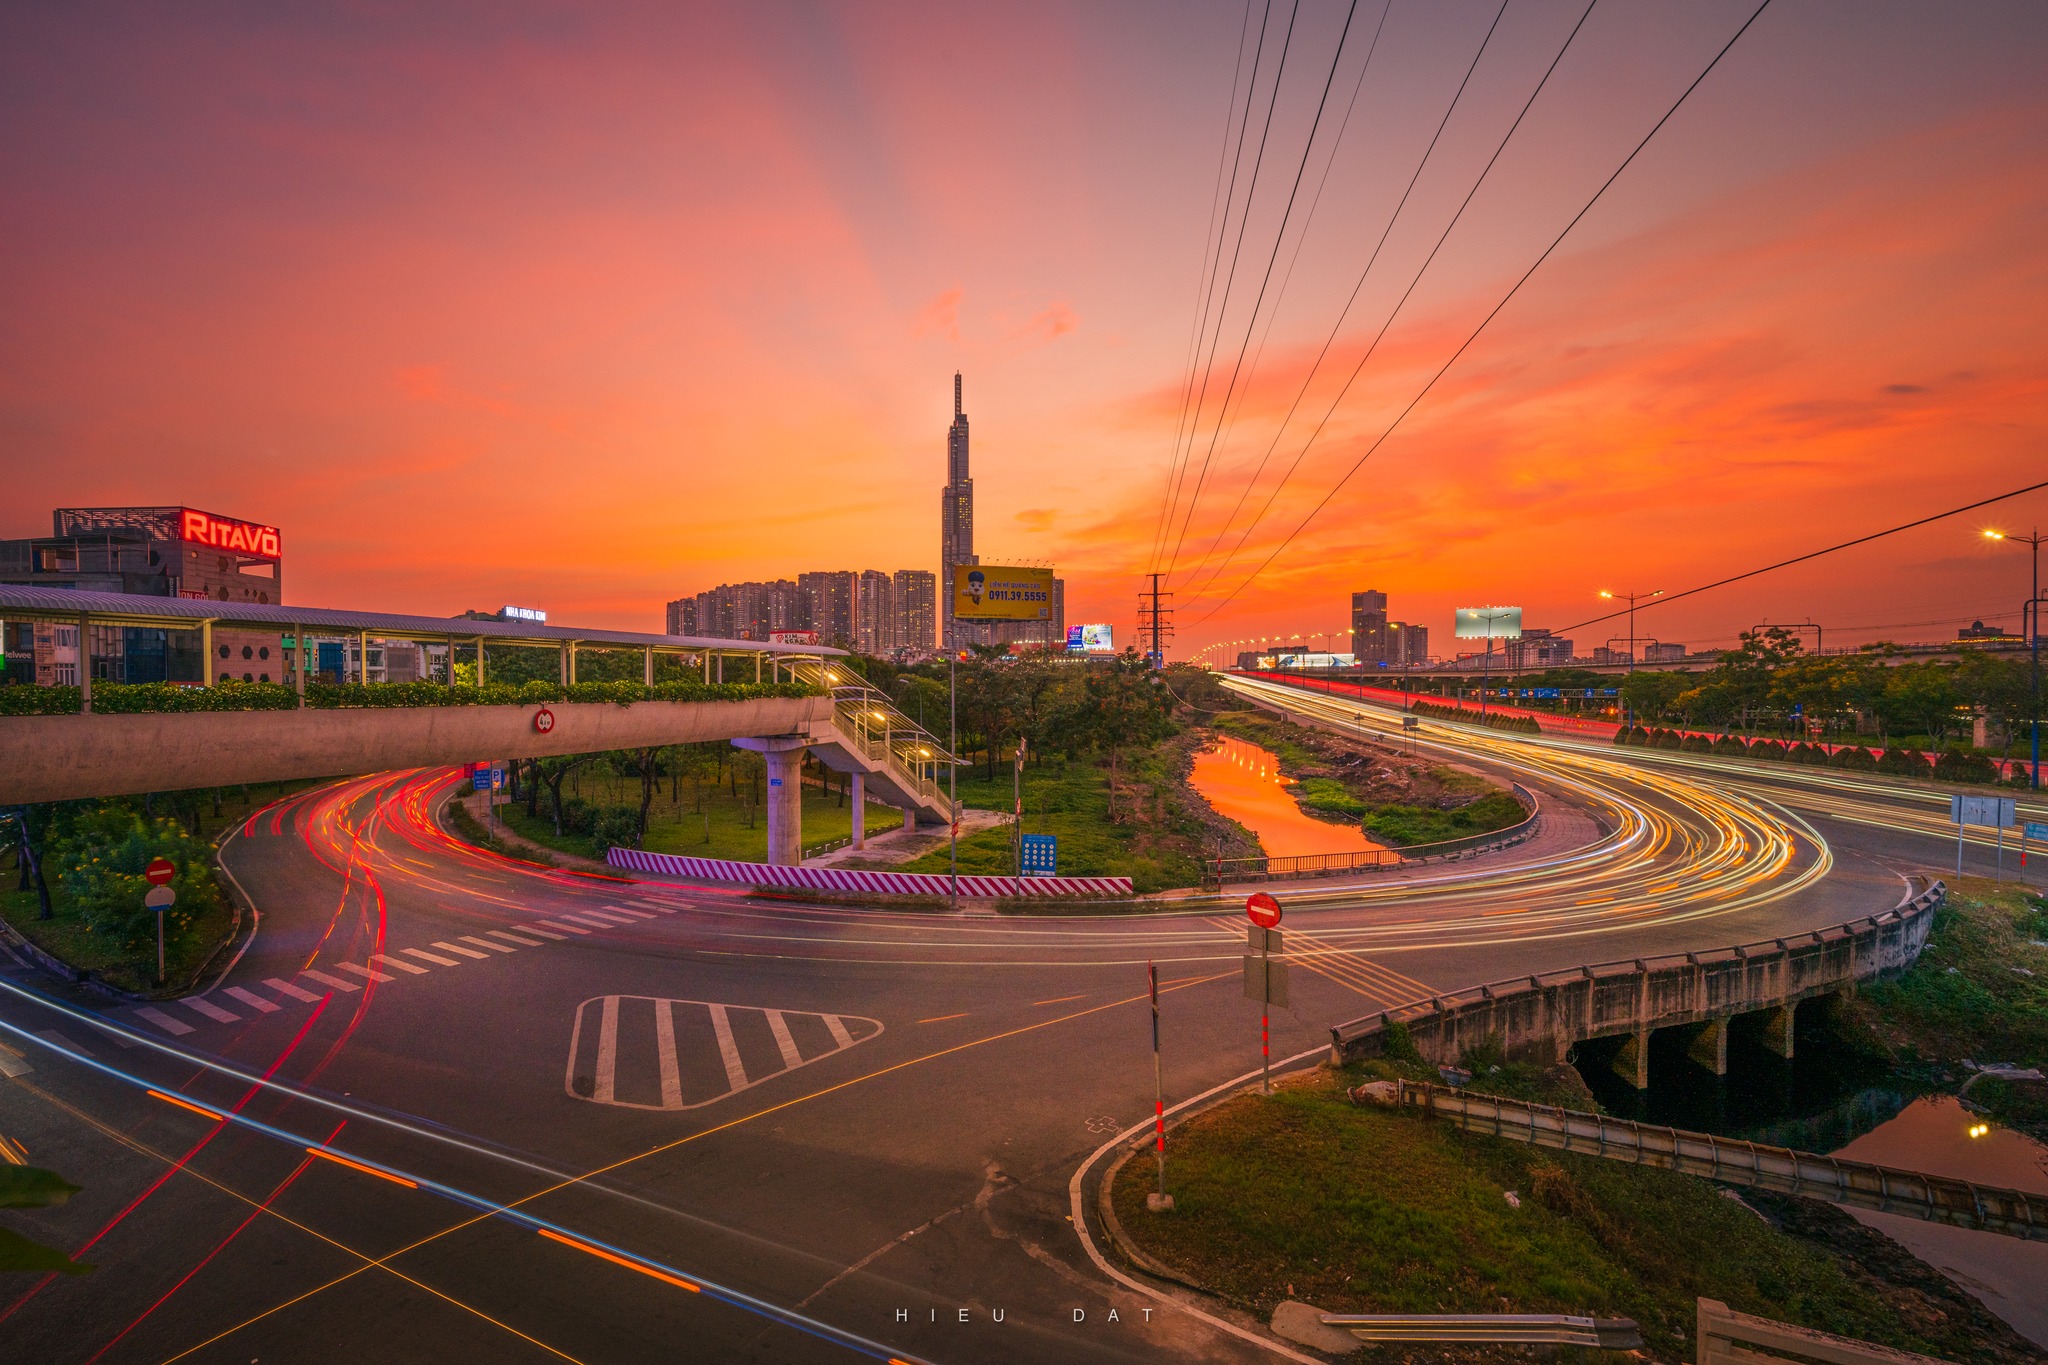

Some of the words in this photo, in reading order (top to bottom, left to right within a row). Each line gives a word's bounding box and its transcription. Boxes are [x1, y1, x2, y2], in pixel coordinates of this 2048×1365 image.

[989, 590, 1047, 601] 0911.39.5555
[505, 606, 519, 618] NHA
[519, 608, 535, 620] KHOA
